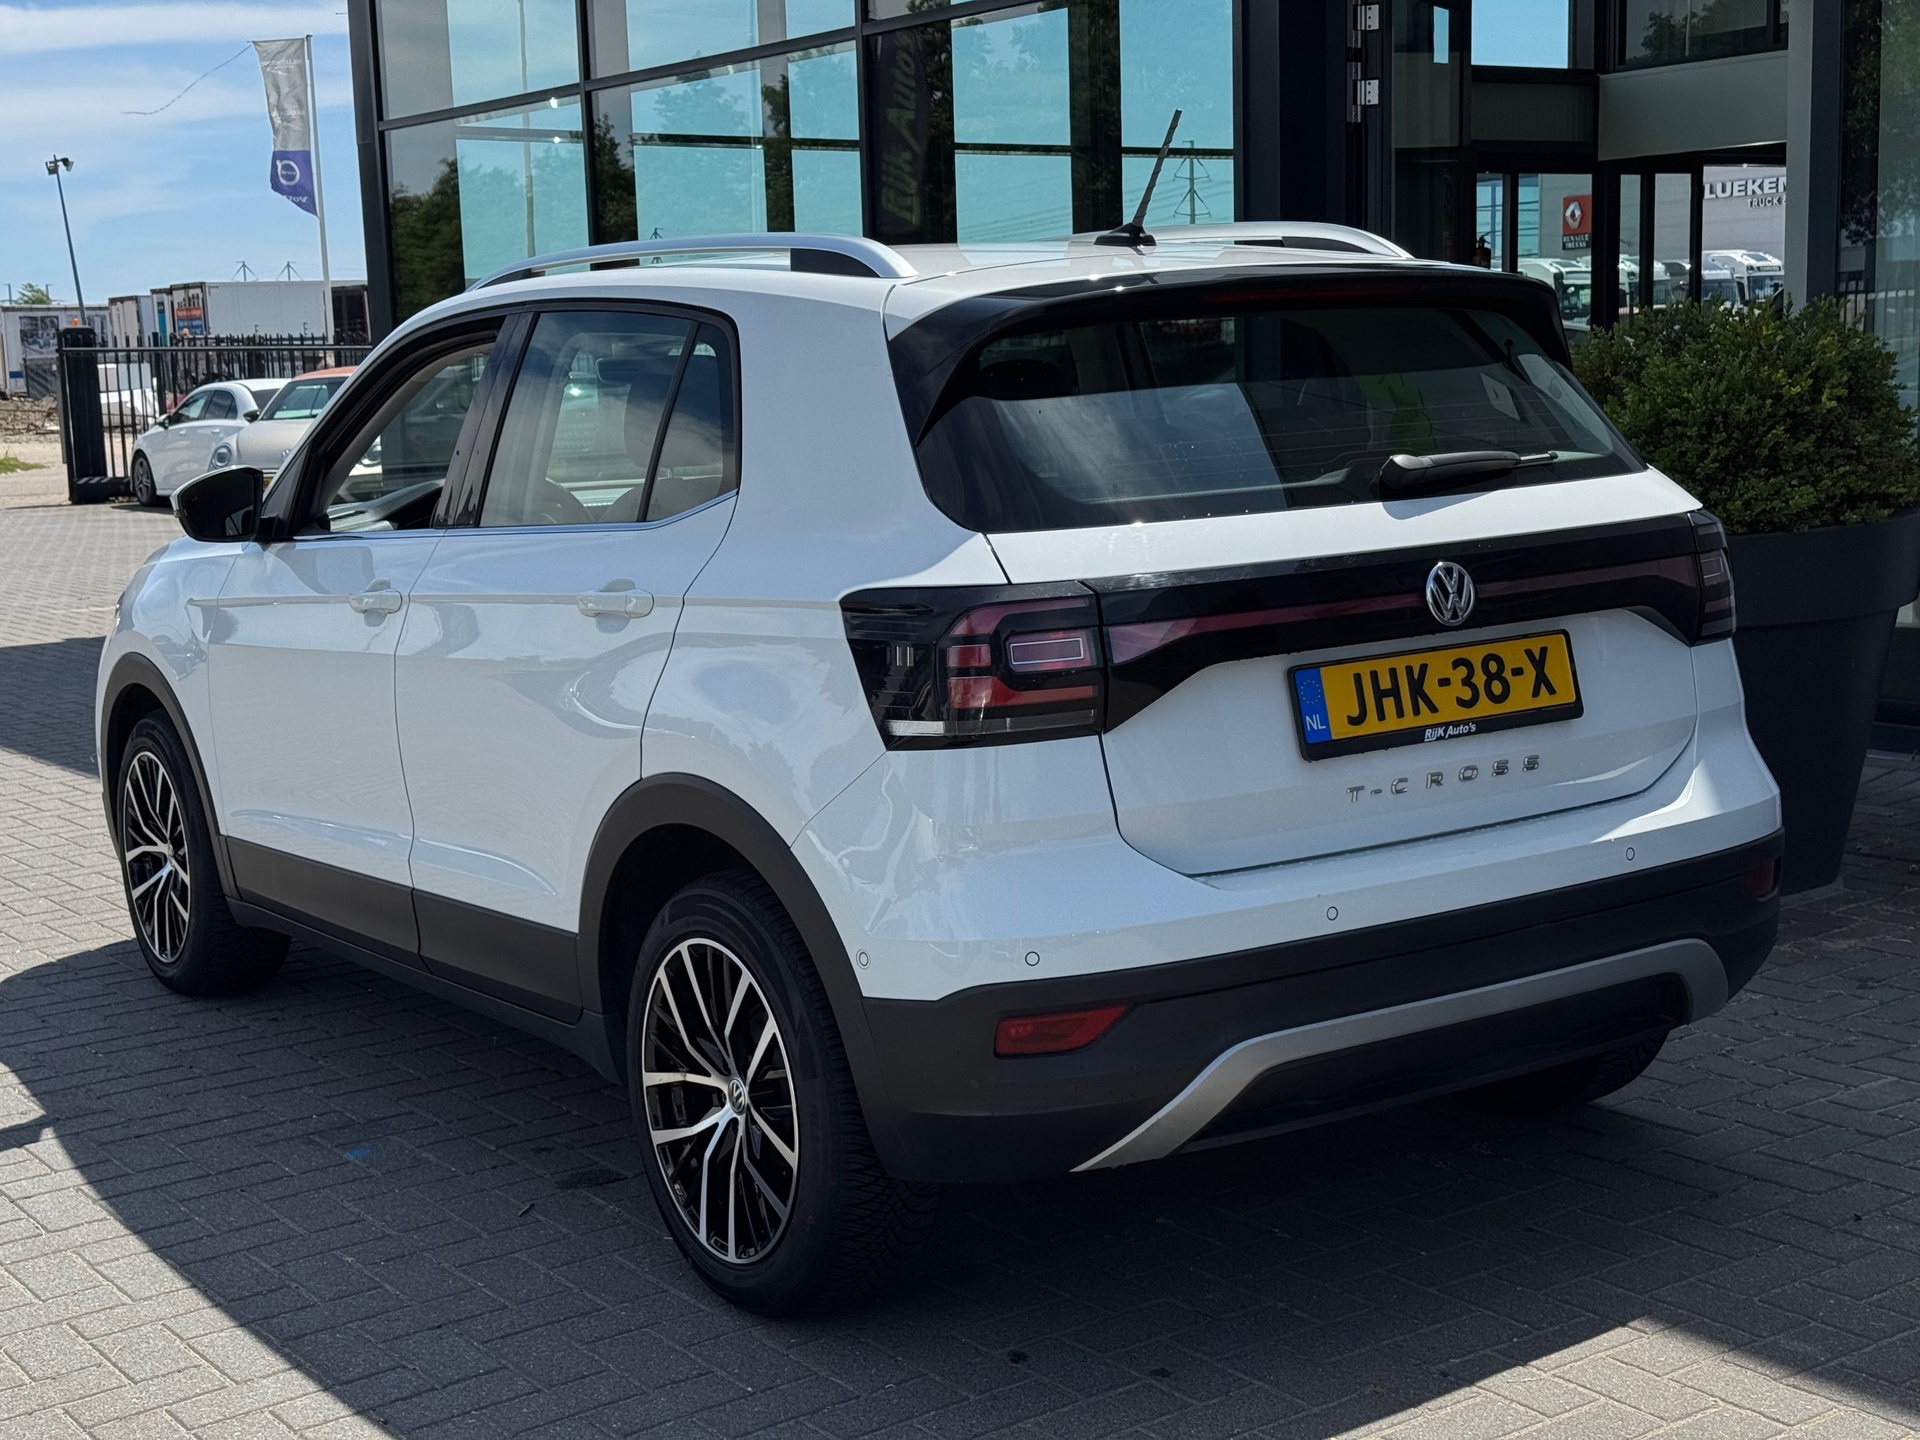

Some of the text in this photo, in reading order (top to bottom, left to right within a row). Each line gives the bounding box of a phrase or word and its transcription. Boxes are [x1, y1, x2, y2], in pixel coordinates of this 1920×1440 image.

[1747, 195, 1780, 208] TRUCK
[1346, 646, 1557, 726] JHK-38-X
[1306, 714, 1326, 732] NL
[1445, 722, 1477, 739] Auto's
[1345, 754, 1539, 803] T-CROSS
